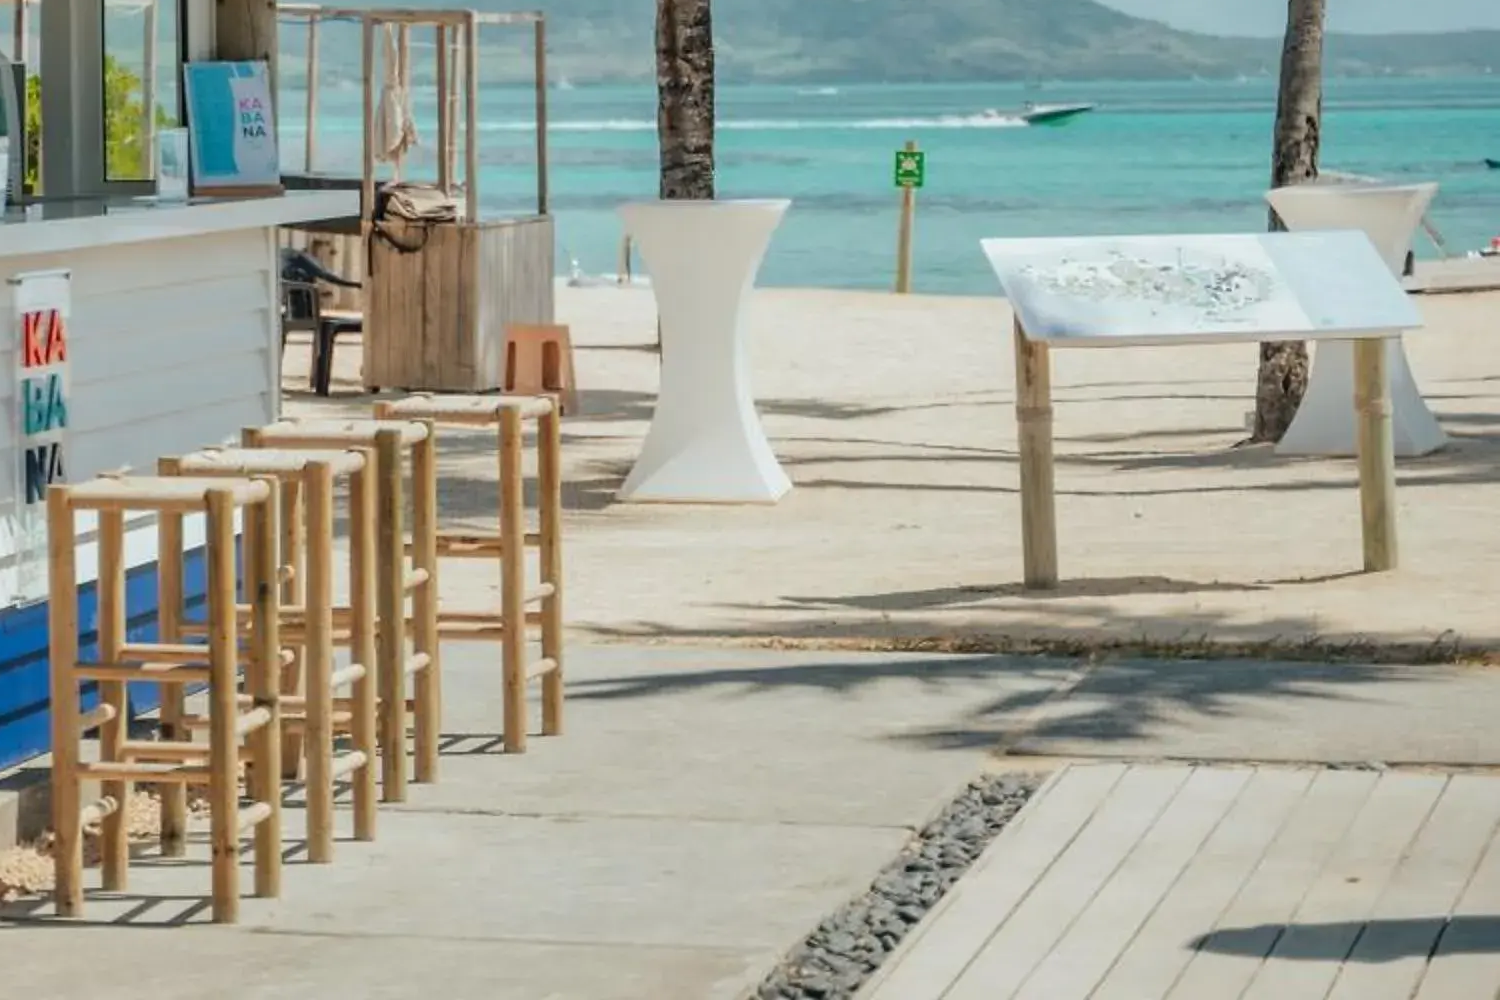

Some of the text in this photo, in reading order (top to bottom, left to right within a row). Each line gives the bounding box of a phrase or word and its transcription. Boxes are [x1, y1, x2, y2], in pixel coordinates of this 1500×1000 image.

[22, 309, 66, 367] KA
[22, 373, 66, 436] BA
[25, 442, 64, 504] NA
